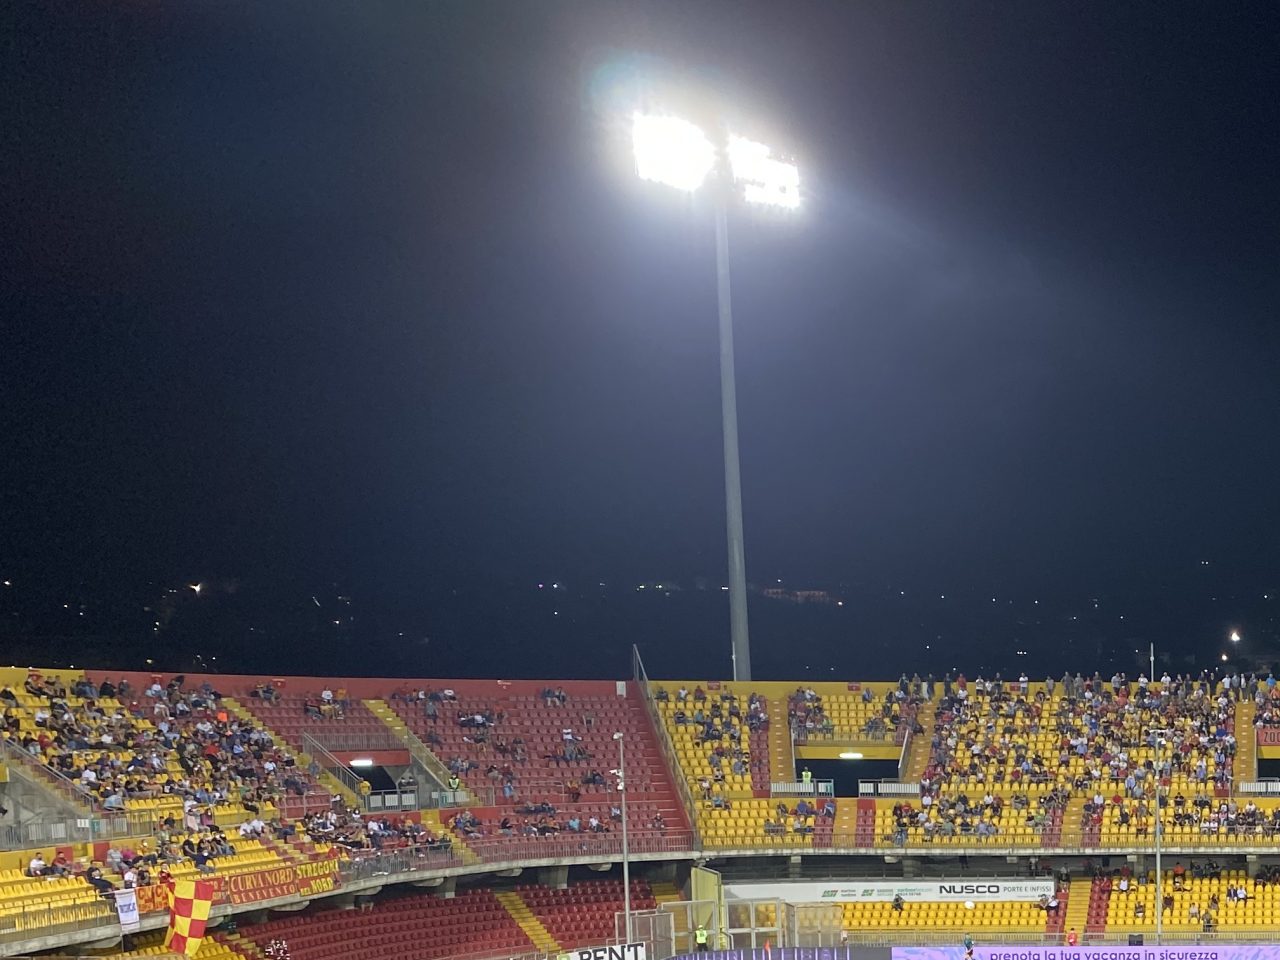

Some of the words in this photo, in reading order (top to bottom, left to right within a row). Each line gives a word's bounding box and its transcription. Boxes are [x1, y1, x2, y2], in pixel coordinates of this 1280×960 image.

[230, 873, 264, 892] CURVA
[265, 867, 293, 886] NORD
[310, 877, 333, 893] NORD
[233, 884, 296, 903] BENEVENTO
[939, 885, 1000, 894] NUSCO
[1045, 950, 1056, 960] la
[1060, 950, 1081, 960] tua
[1085, 952, 1140, 960] vacanza
[1144, 950, 1155, 960] in
[1160, 950, 1218, 960] sicurezza
